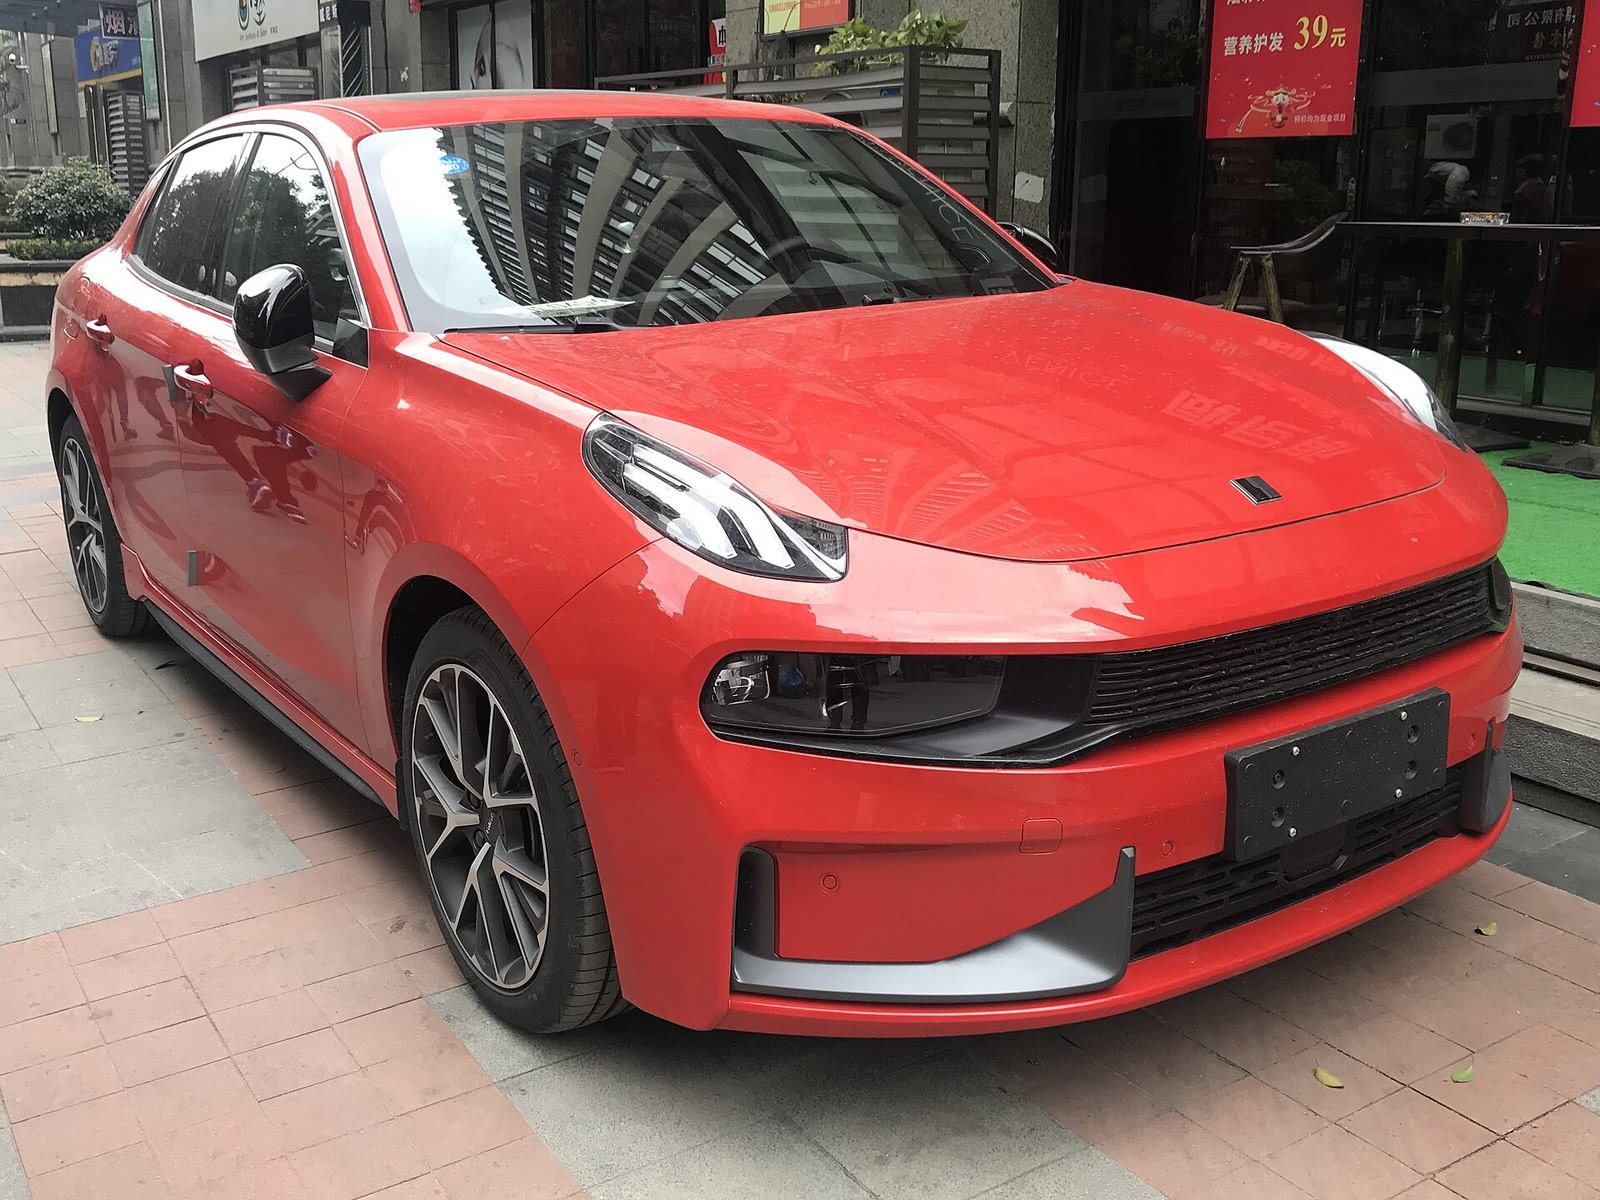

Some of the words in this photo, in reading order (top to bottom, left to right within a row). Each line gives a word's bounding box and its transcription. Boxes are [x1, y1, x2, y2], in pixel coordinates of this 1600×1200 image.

[1223, 32, 1285, 57] 营养护发
[1294, 113, 1347, 124] 特价均为现金项目
